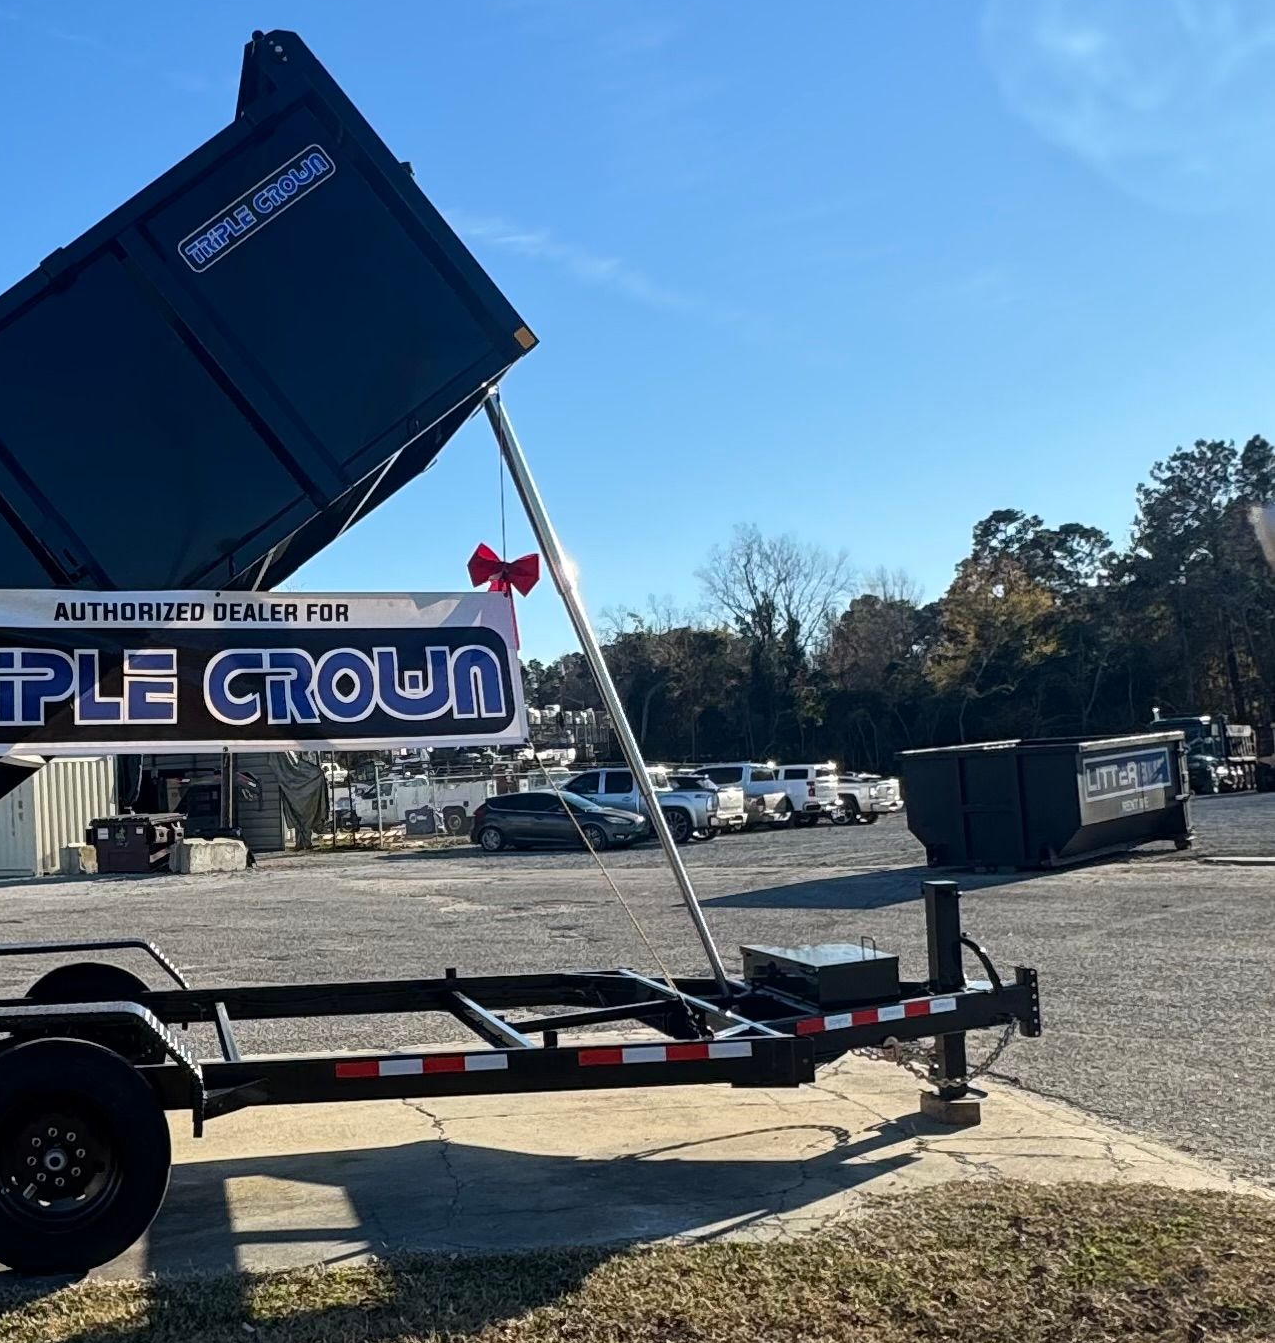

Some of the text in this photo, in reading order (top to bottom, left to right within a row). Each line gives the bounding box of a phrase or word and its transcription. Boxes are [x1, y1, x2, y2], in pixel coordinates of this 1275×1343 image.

[185, 153, 329, 264] TRIPLE CROWN
[53, 602, 349, 622] AUTHORIZED DEALER FOR
[203, 645, 506, 726] CROWN
